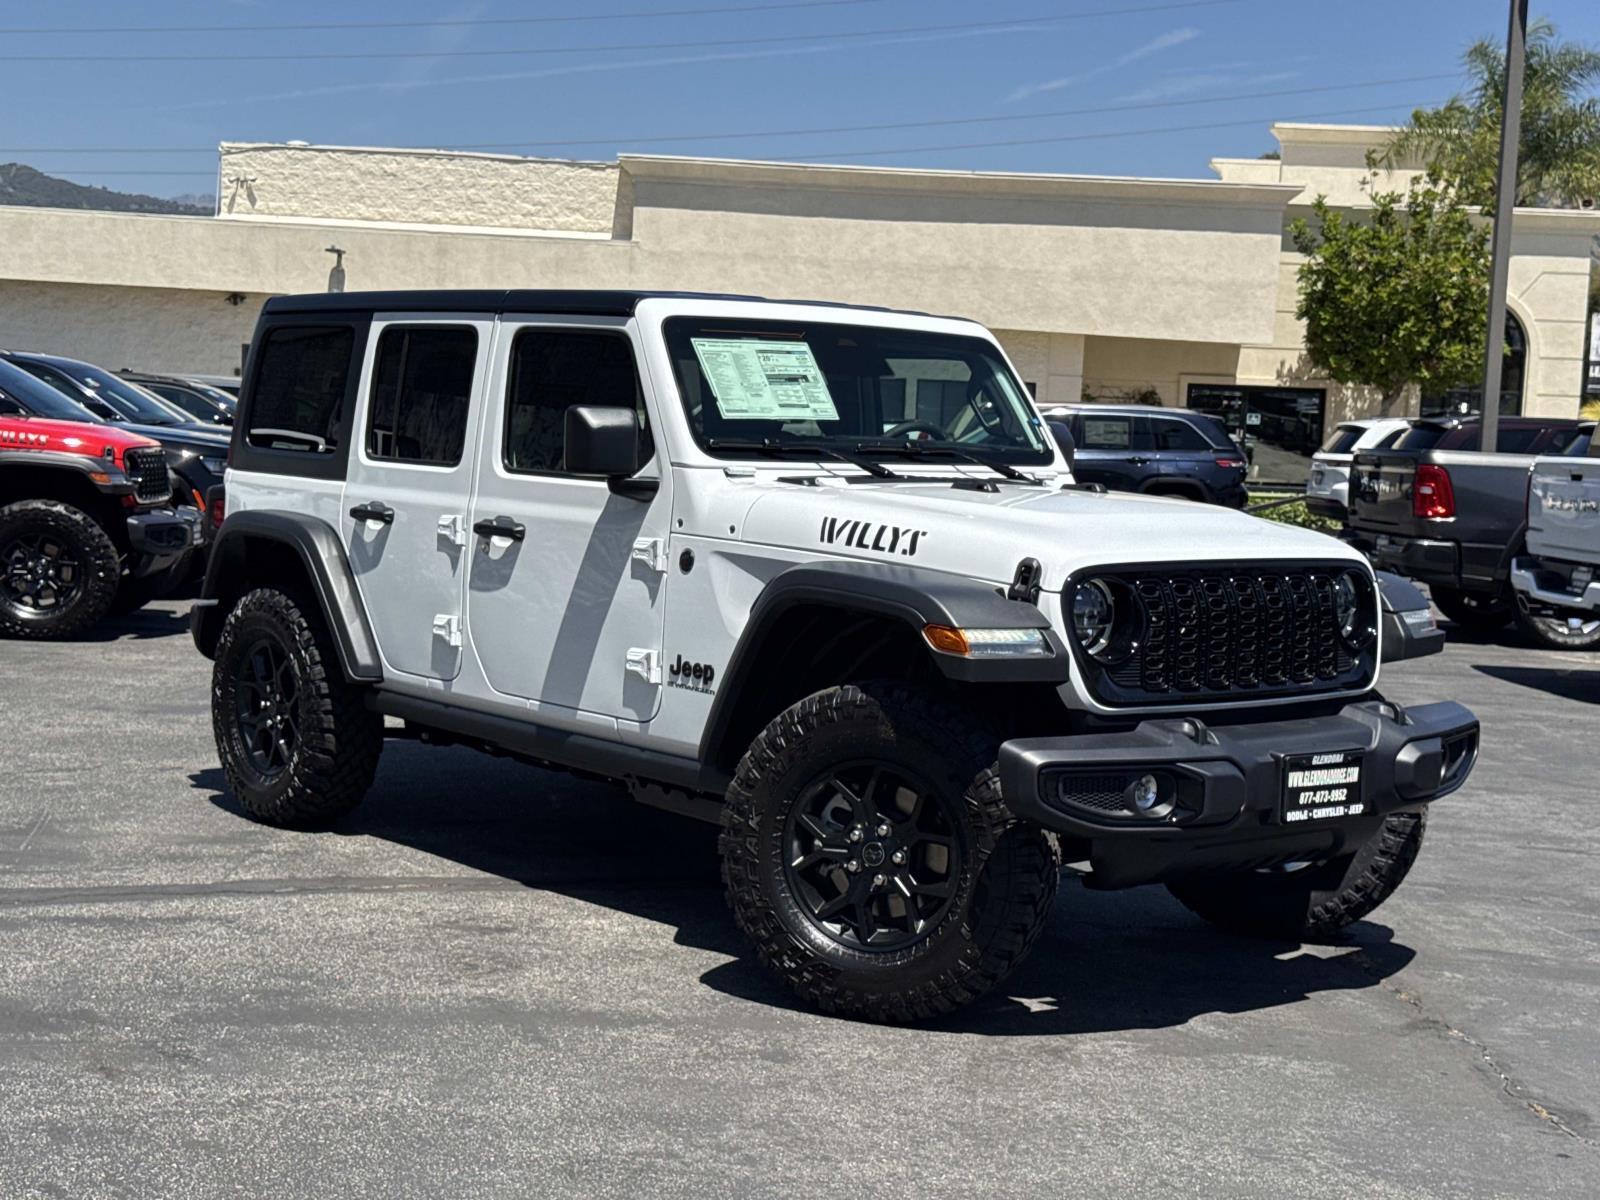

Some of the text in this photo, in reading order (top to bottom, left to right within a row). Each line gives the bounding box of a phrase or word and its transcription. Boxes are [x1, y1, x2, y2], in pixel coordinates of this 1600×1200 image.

[0, 430, 50, 447] ILLYS
[819, 516, 929, 556] WILLYS
[669, 654, 715, 685] Jeep
[1312, 753, 1344, 766] GLENDORA
[1286, 803, 1364, 822] DODGE CHRYSLER JEEP
